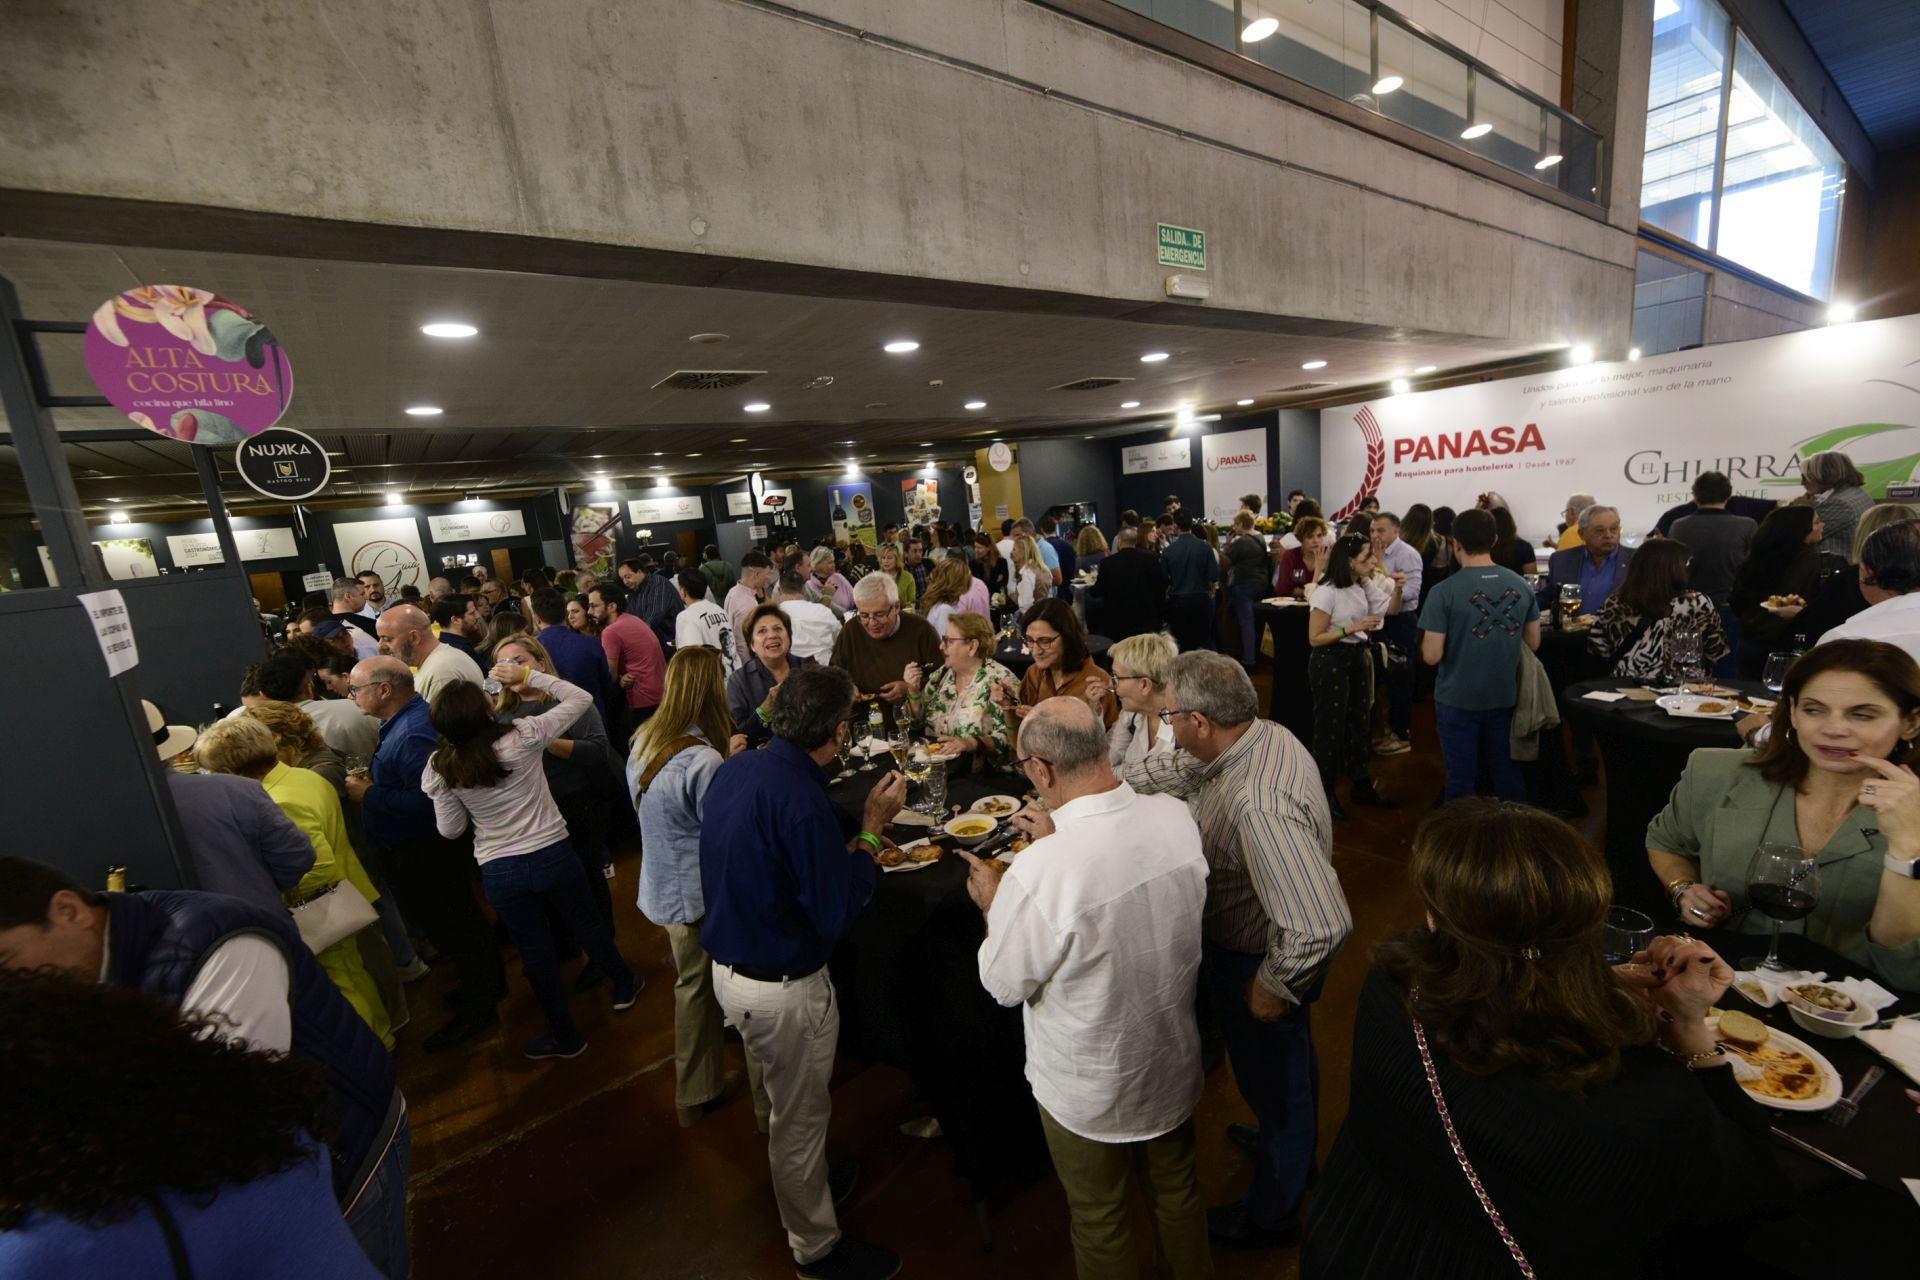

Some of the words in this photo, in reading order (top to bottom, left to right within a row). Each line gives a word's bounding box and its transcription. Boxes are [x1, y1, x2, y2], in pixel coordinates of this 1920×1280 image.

[1161, 228, 1186, 246] SALIDA
[1193, 233, 1202, 248] DE
[1160, 245, 1203, 265] EMERGENCIA
[126, 347, 204, 369] ALTA
[127, 372, 274, 396] COSTURA
[1522, 382, 1555, 395] Unidos
[1648, 359, 1713, 378] maquinaria
[1582, 385, 1641, 404] profesional
[1642, 385, 1663, 395] van
[1666, 381, 1682, 392] de
[1684, 378, 1695, 389] la
[133, 400, 170, 408] cocina
[172, 400, 193, 409] que
[1394, 423, 1546, 464] PANASA
[1220, 454, 1257, 465] PANASA
[1640, 462, 1659, 474] EL
[1395, 470, 1442, 480] Maquinaria
[1444, 468, 1464, 477] para
[1525, 461, 1551, 470] Desde
